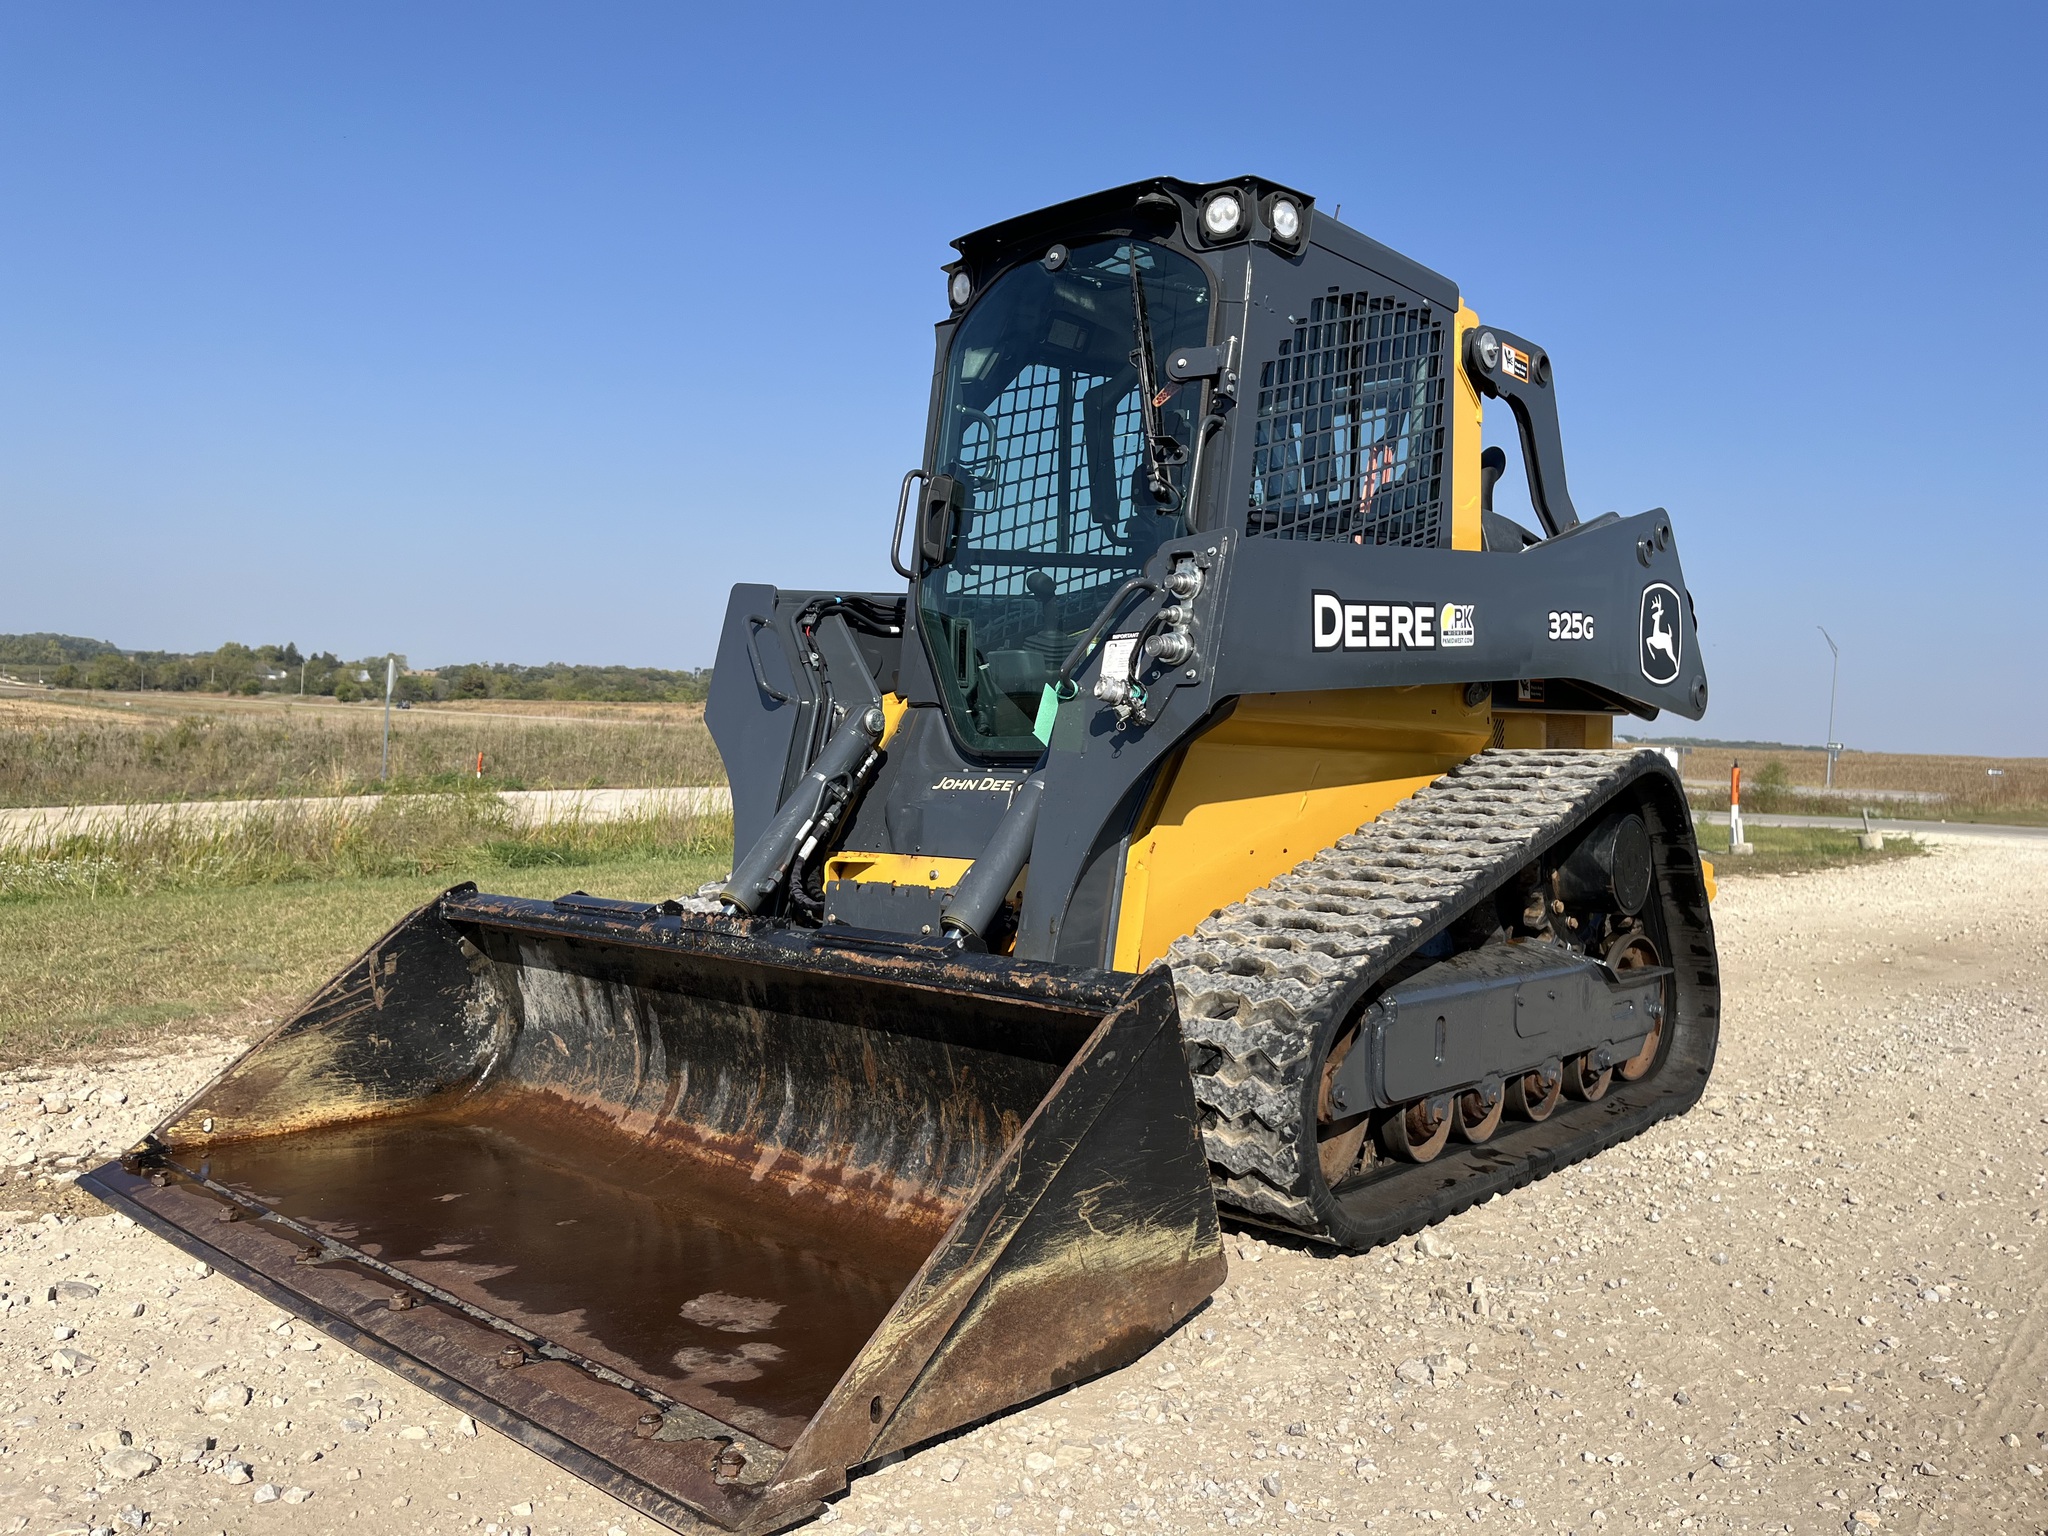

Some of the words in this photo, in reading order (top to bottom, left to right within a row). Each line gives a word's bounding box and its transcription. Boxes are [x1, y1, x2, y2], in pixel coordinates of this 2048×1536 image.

[1314, 594, 1434, 647] DEERE
[1548, 611, 1594, 640] 325G
[932, 777, 978, 790] JOHN
[978, 778, 1022, 791] DEE
